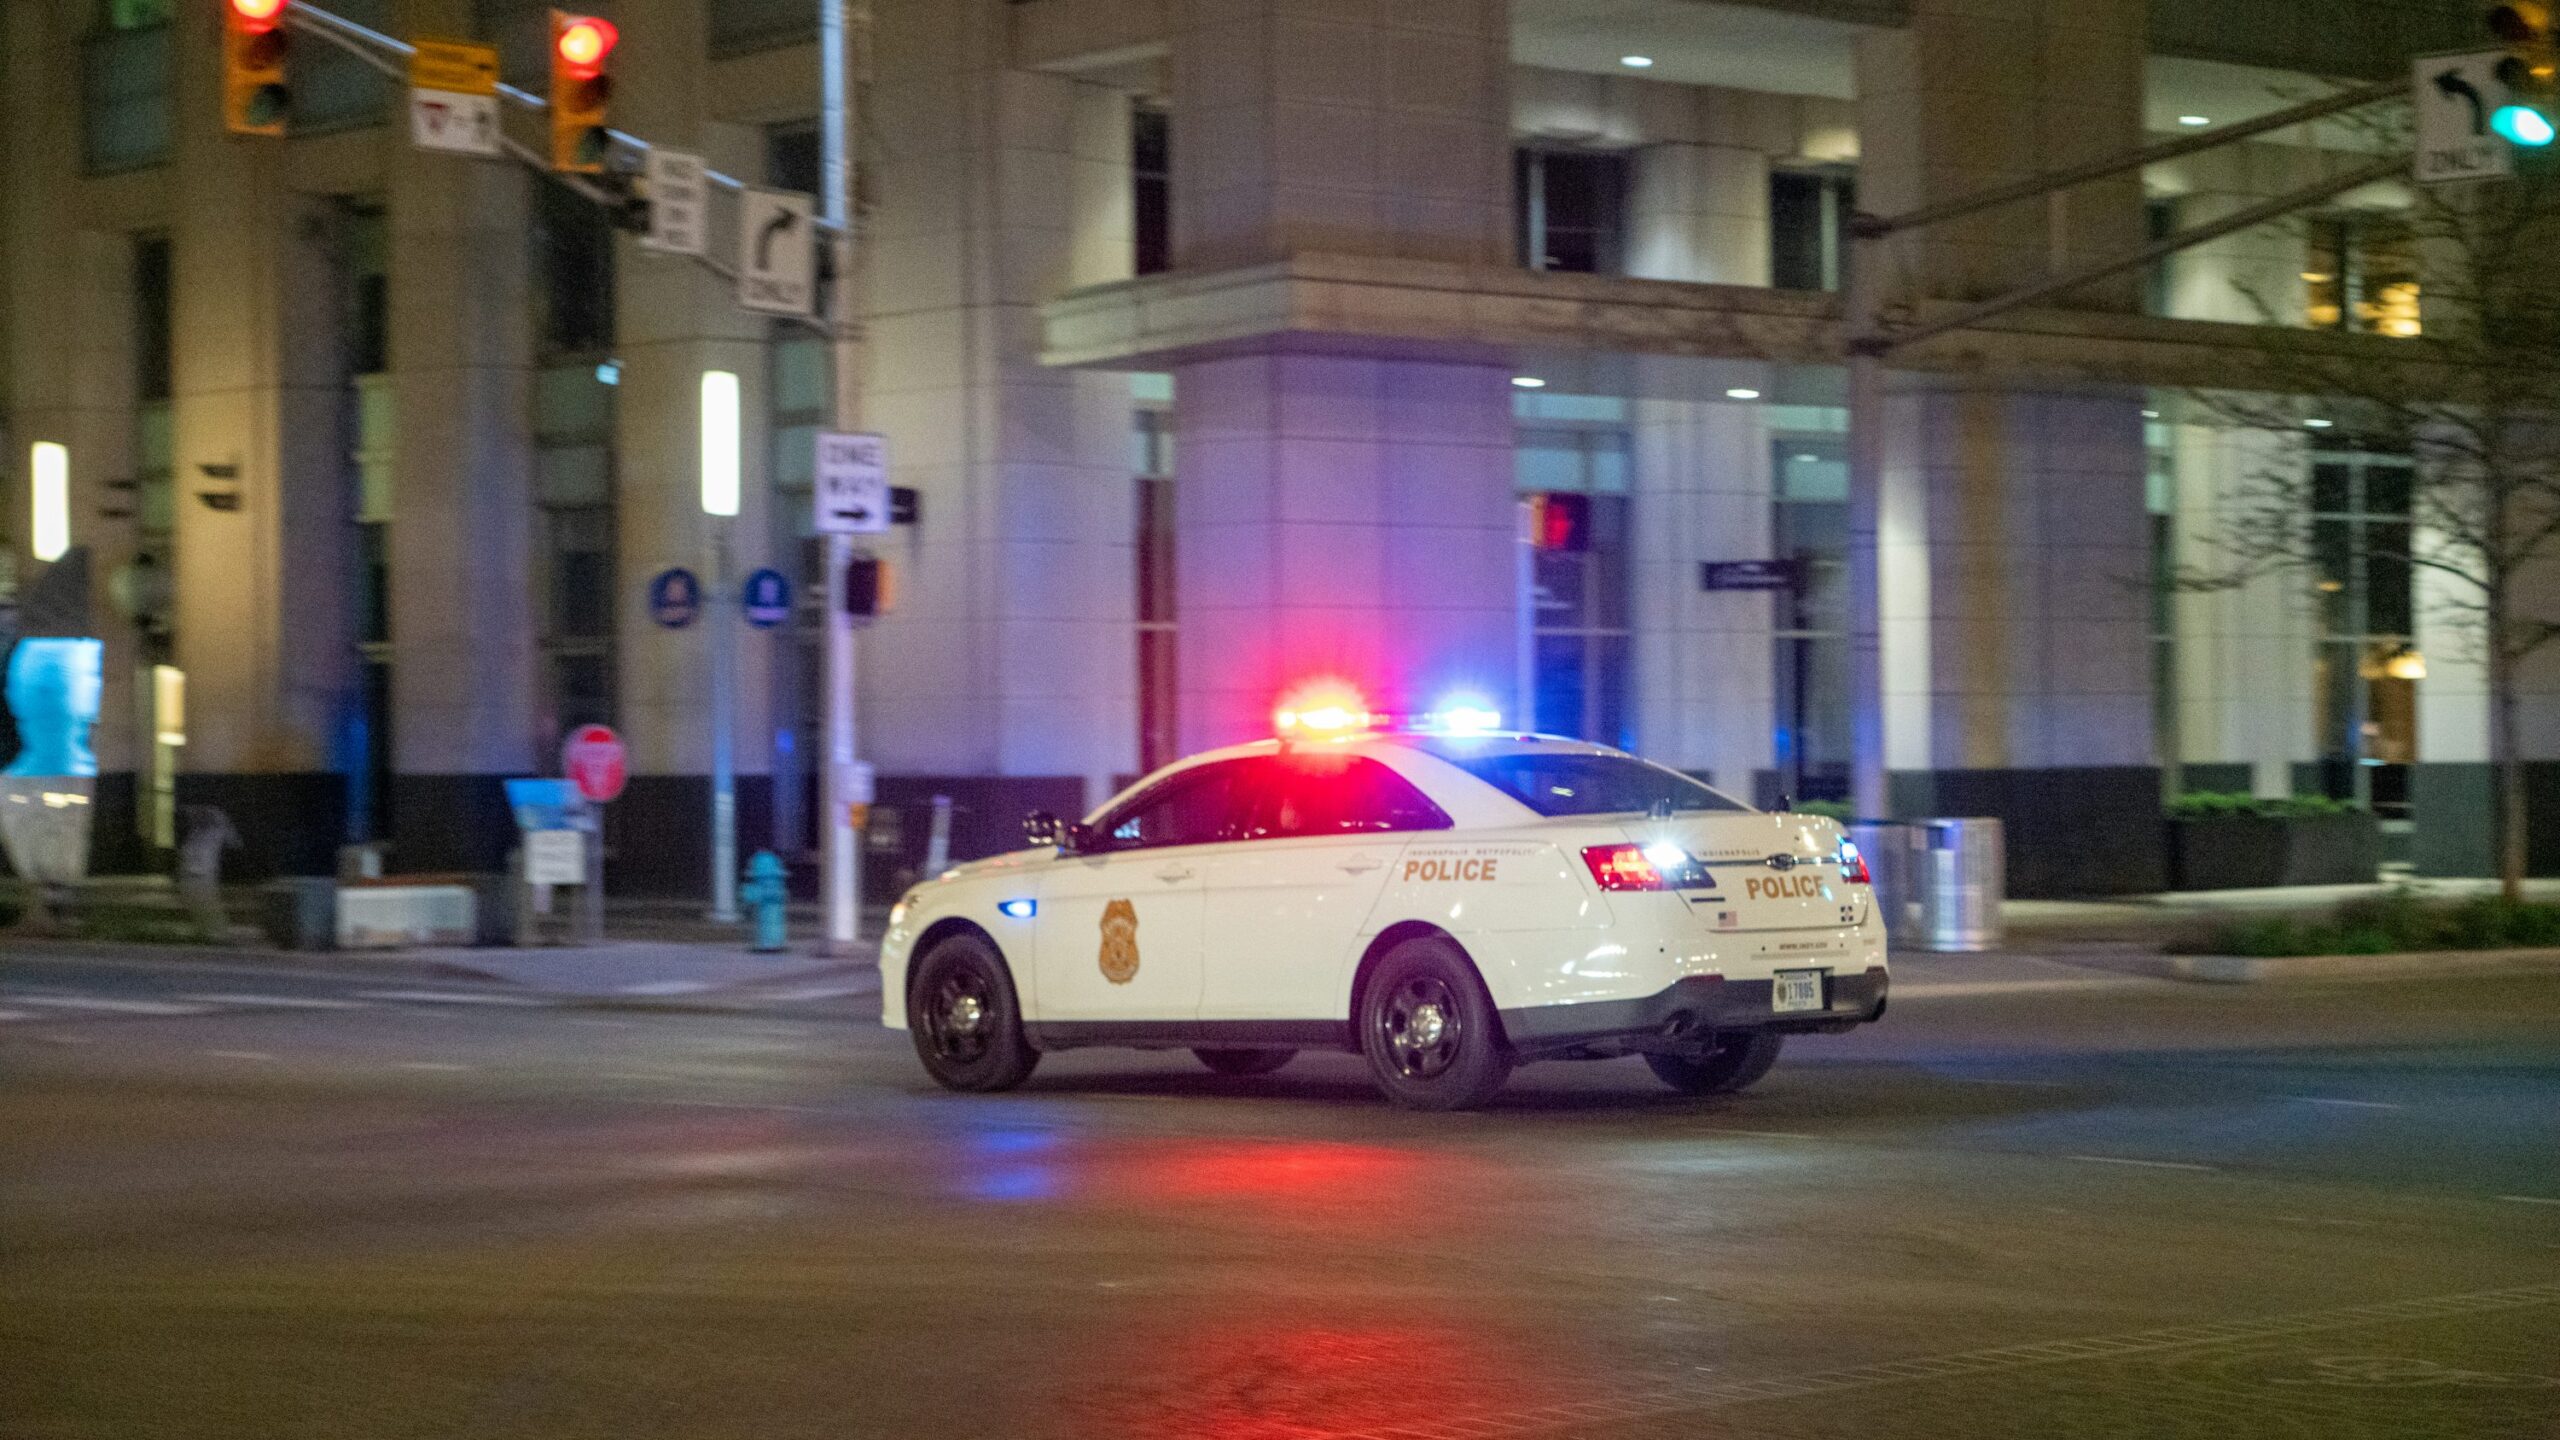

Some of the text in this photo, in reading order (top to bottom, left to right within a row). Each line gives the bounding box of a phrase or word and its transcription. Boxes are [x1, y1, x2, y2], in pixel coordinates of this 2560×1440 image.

[828, 442, 882, 467] ONE
[1403, 858, 1498, 882] POLICE
[1745, 874, 1825, 900] POLICE
